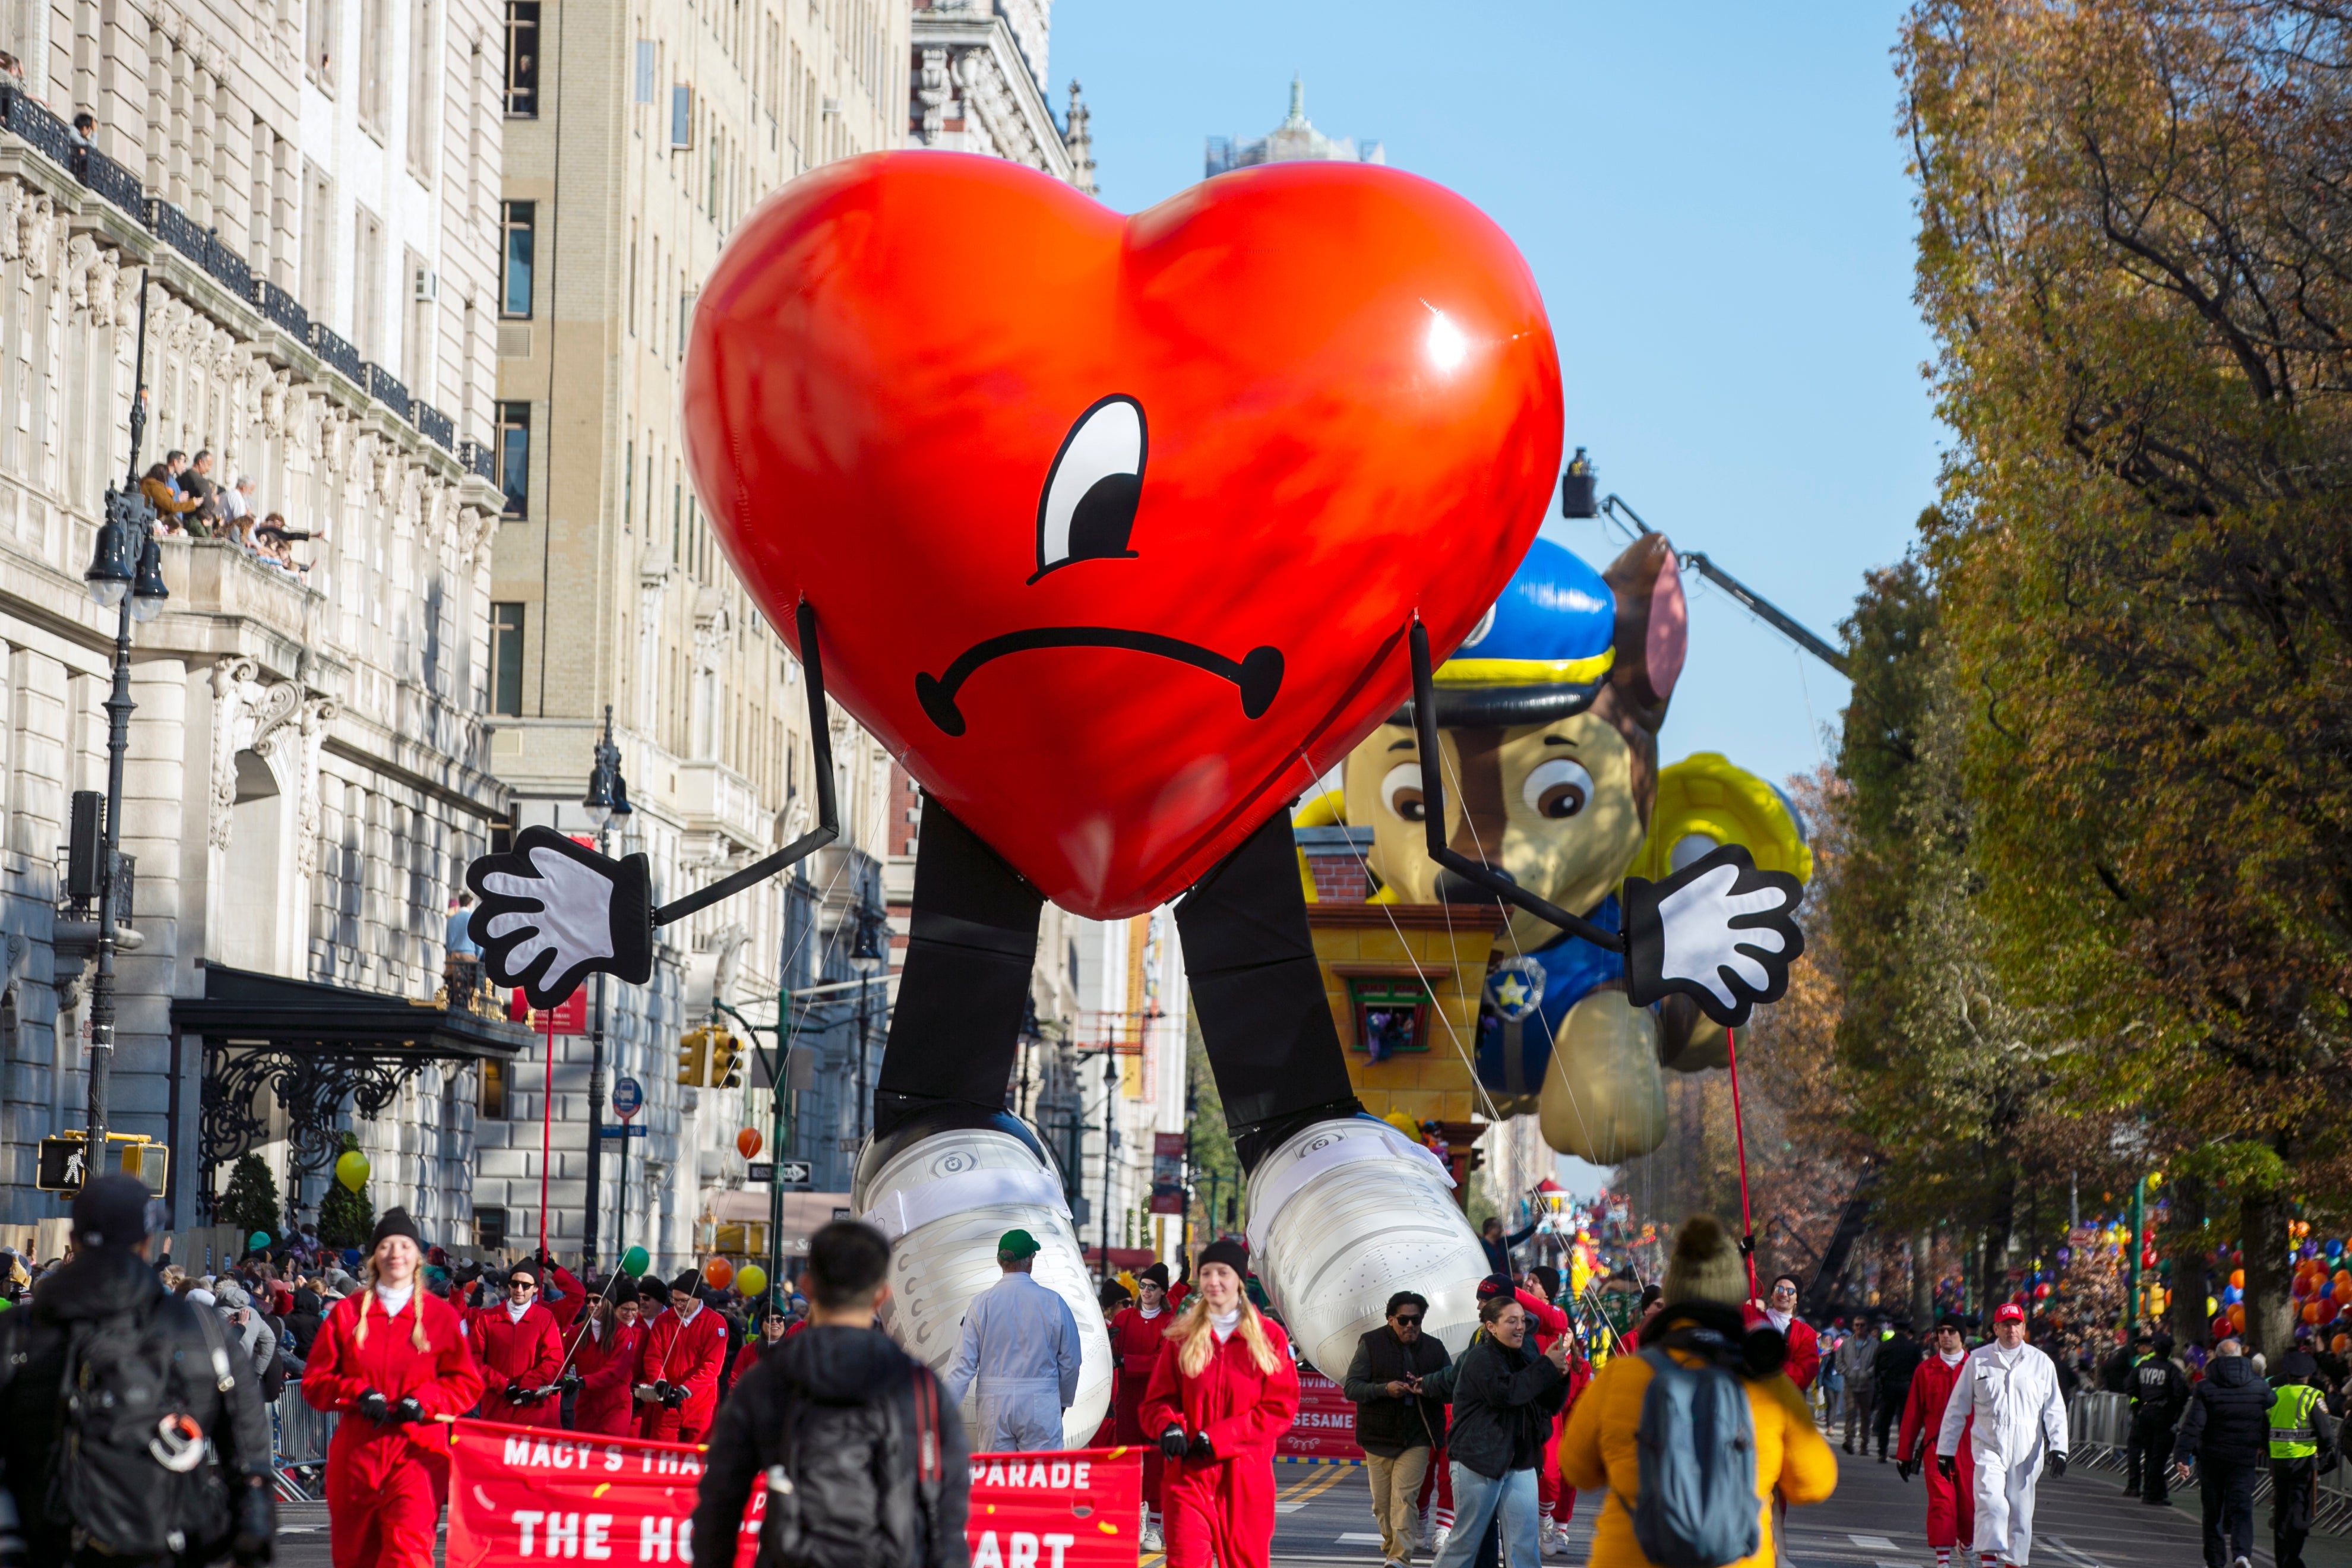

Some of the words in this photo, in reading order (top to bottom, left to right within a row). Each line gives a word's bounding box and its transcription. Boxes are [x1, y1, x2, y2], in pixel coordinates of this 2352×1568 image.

[2002, 1305, 2019, 1316] CAPTAIN
[2139, 1367, 2166, 1385] NYPD
[1293, 1413, 1354, 1428] SESAME
[503, 1434, 624, 1471] MACYS
[969, 1458, 1091, 1489] PARADE
[511, 1510, 613, 1560] THE
[963, 1530, 1074, 1568] ART
